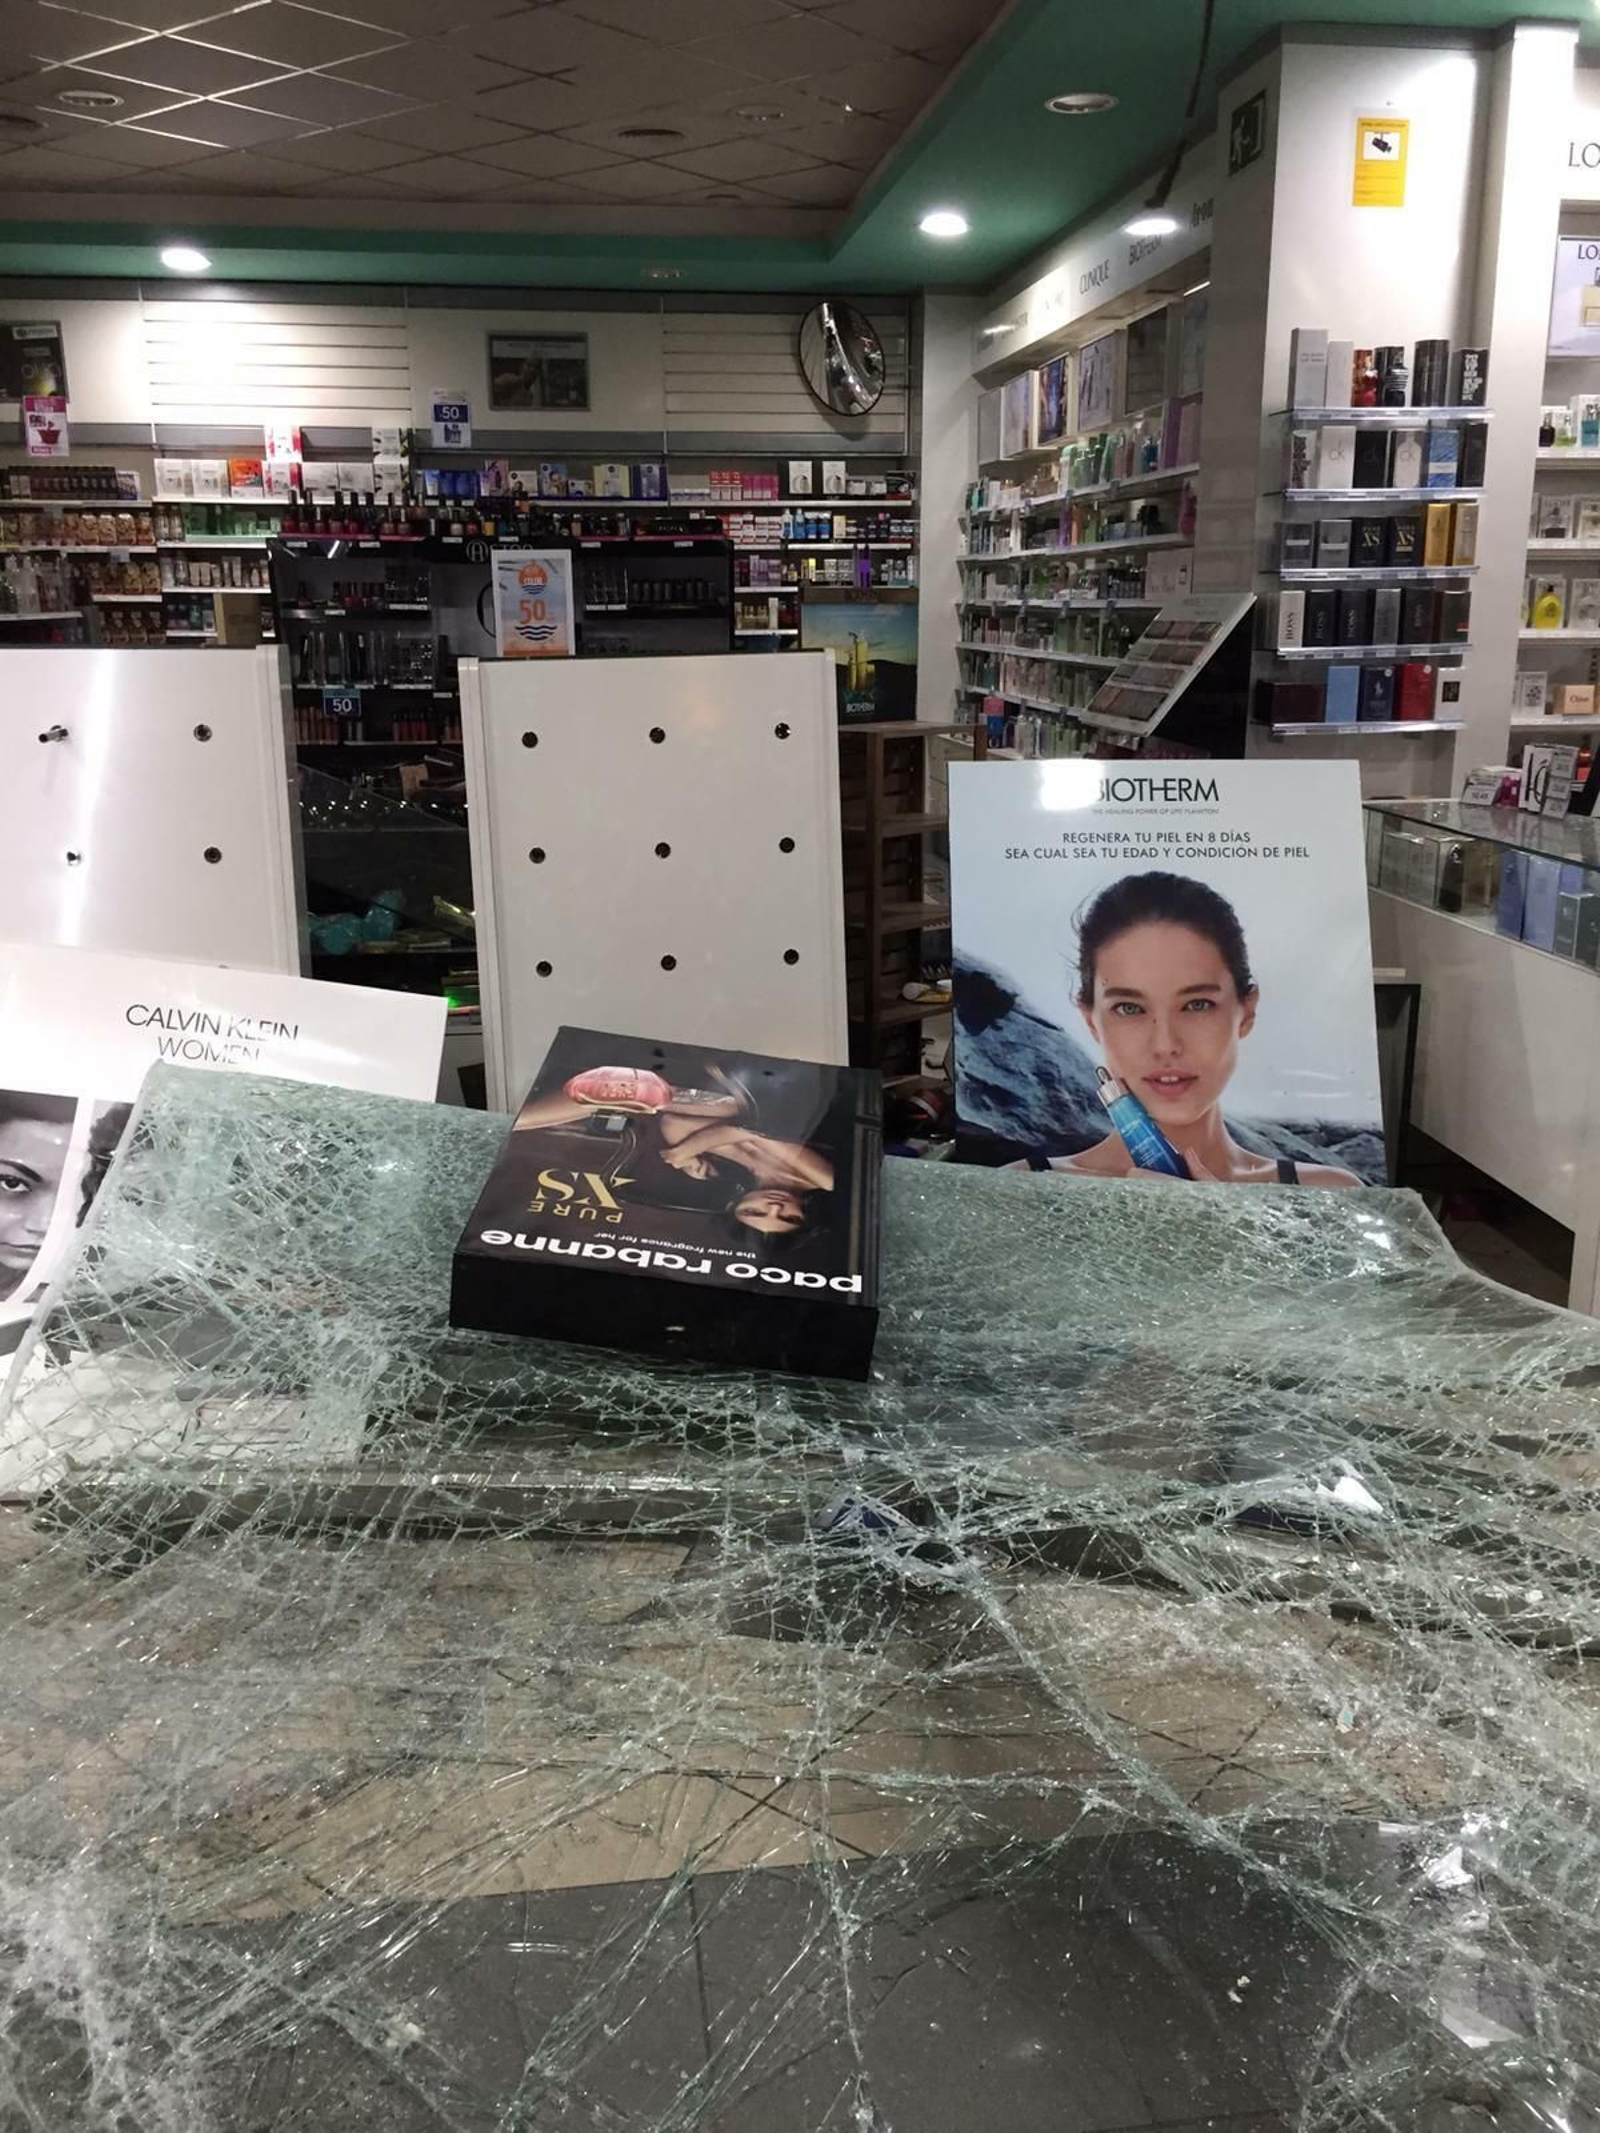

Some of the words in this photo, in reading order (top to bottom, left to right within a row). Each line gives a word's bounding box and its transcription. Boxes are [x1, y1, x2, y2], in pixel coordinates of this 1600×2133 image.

[1578, 244, 1600, 260] LO
[442, 406, 460, 420] 50
[519, 599, 546, 625] 50
[333, 698, 353, 713] 50
[1063, 832, 1131, 843] REGENERA
[1135, 832, 1151, 843] TU
[1156, 832, 1181, 843] PIEL
[1186, 832, 1204, 842] EN
[1208, 832, 1216, 842] 8
[1220, 829, 1251, 842] DÍAS
[1005, 848, 1030, 859] SEA
[1033, 848, 1068, 859] CUAL
[1073, 848, 1097, 858] SEA
[1102, 848, 1118, 858] TU
[1123, 847, 1159, 858] EDAD
[1163, 847, 1171, 858] Y
[1263, 847, 1280, 858] DE
[1284, 847, 1310, 858] PIEL
[126, 1004, 222, 1036] CALVIN
[227, 1016, 299, 1042] KLEIN
[534, 1168, 636, 1210] XS
[527, 1200, 624, 1224] PURE
[593, 1232, 617, 1241] her
[618, 1235, 638, 1244] for
[480, 1229, 713, 1274] rabanne
[640, 1237, 705, 1254] fragrance
[707, 1248, 733, 1256] new
[736, 1251, 757, 1259] the
[725, 1263, 863, 1293] paco
